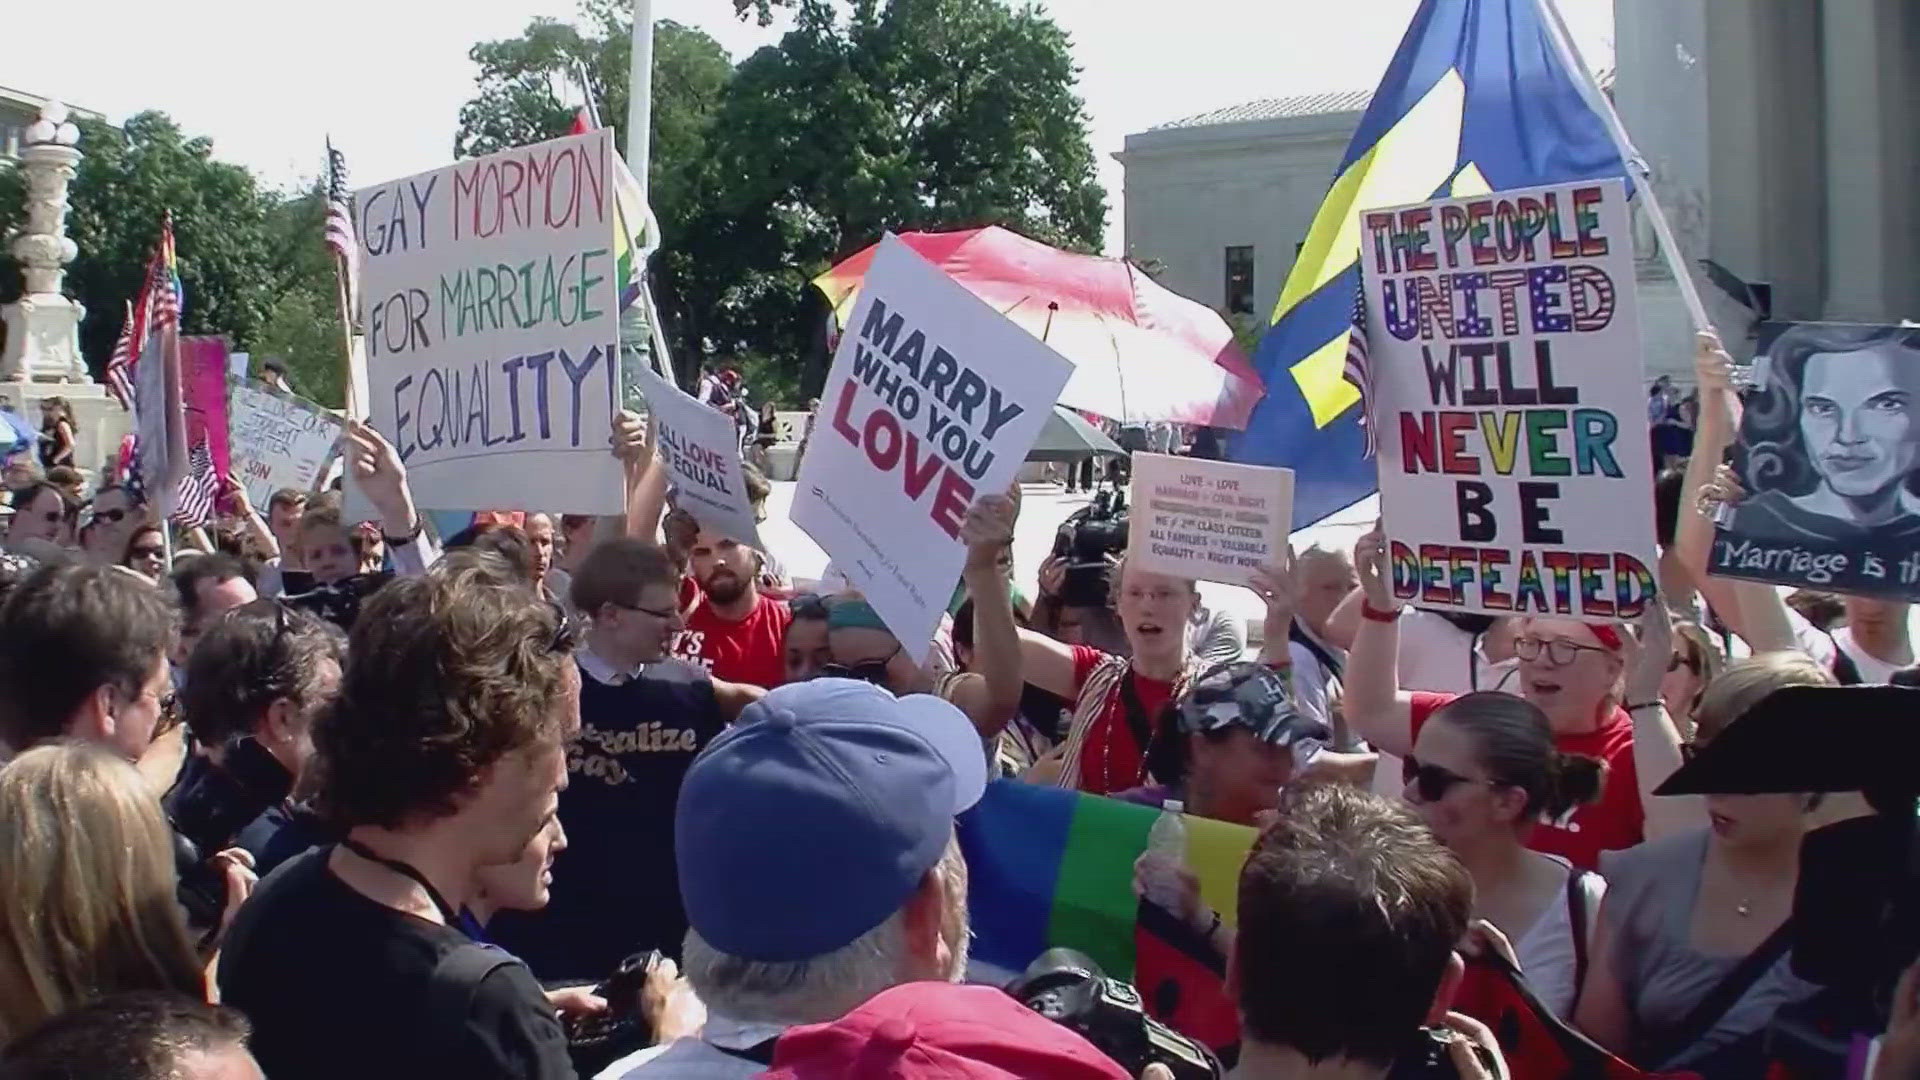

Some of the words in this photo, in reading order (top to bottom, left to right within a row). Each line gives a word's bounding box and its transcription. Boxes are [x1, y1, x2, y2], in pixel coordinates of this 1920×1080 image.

[363, 175, 437, 256] GAY
[454, 137, 604, 241] MORMON
[1367, 206, 1438, 274] THE
[1441, 186, 1609, 268] PEOPLE
[372, 288, 431, 357] FOR
[440, 249, 609, 340] MARRIAGE
[1382, 265, 1616, 341] UNITED
[394, 344, 616, 461] EQUALITY!
[860, 297, 1024, 441] MARRY
[1422, 340, 1578, 406] WILL
[853, 343, 919, 420] WHO
[926, 404, 995, 480] YOU
[1399, 408, 1626, 478] NEVER
[245, 459, 272, 480] SON
[674, 453, 732, 496] EQUAL
[682, 435, 728, 475] LOVE
[832, 377, 976, 541] LOVE
[1180, 473, 1203, 488] LOVE
[1216, 476, 1240, 491] LOVE
[1150, 529, 1165, 541] ALL
[1151, 543, 1195, 561] EQUALITY
[1197, 520, 1225, 534] CLASS
[1719, 540, 1849, 583] Marriage
[1862, 551, 1887, 578] is
[1390, 540, 1657, 620] DEFEATED
